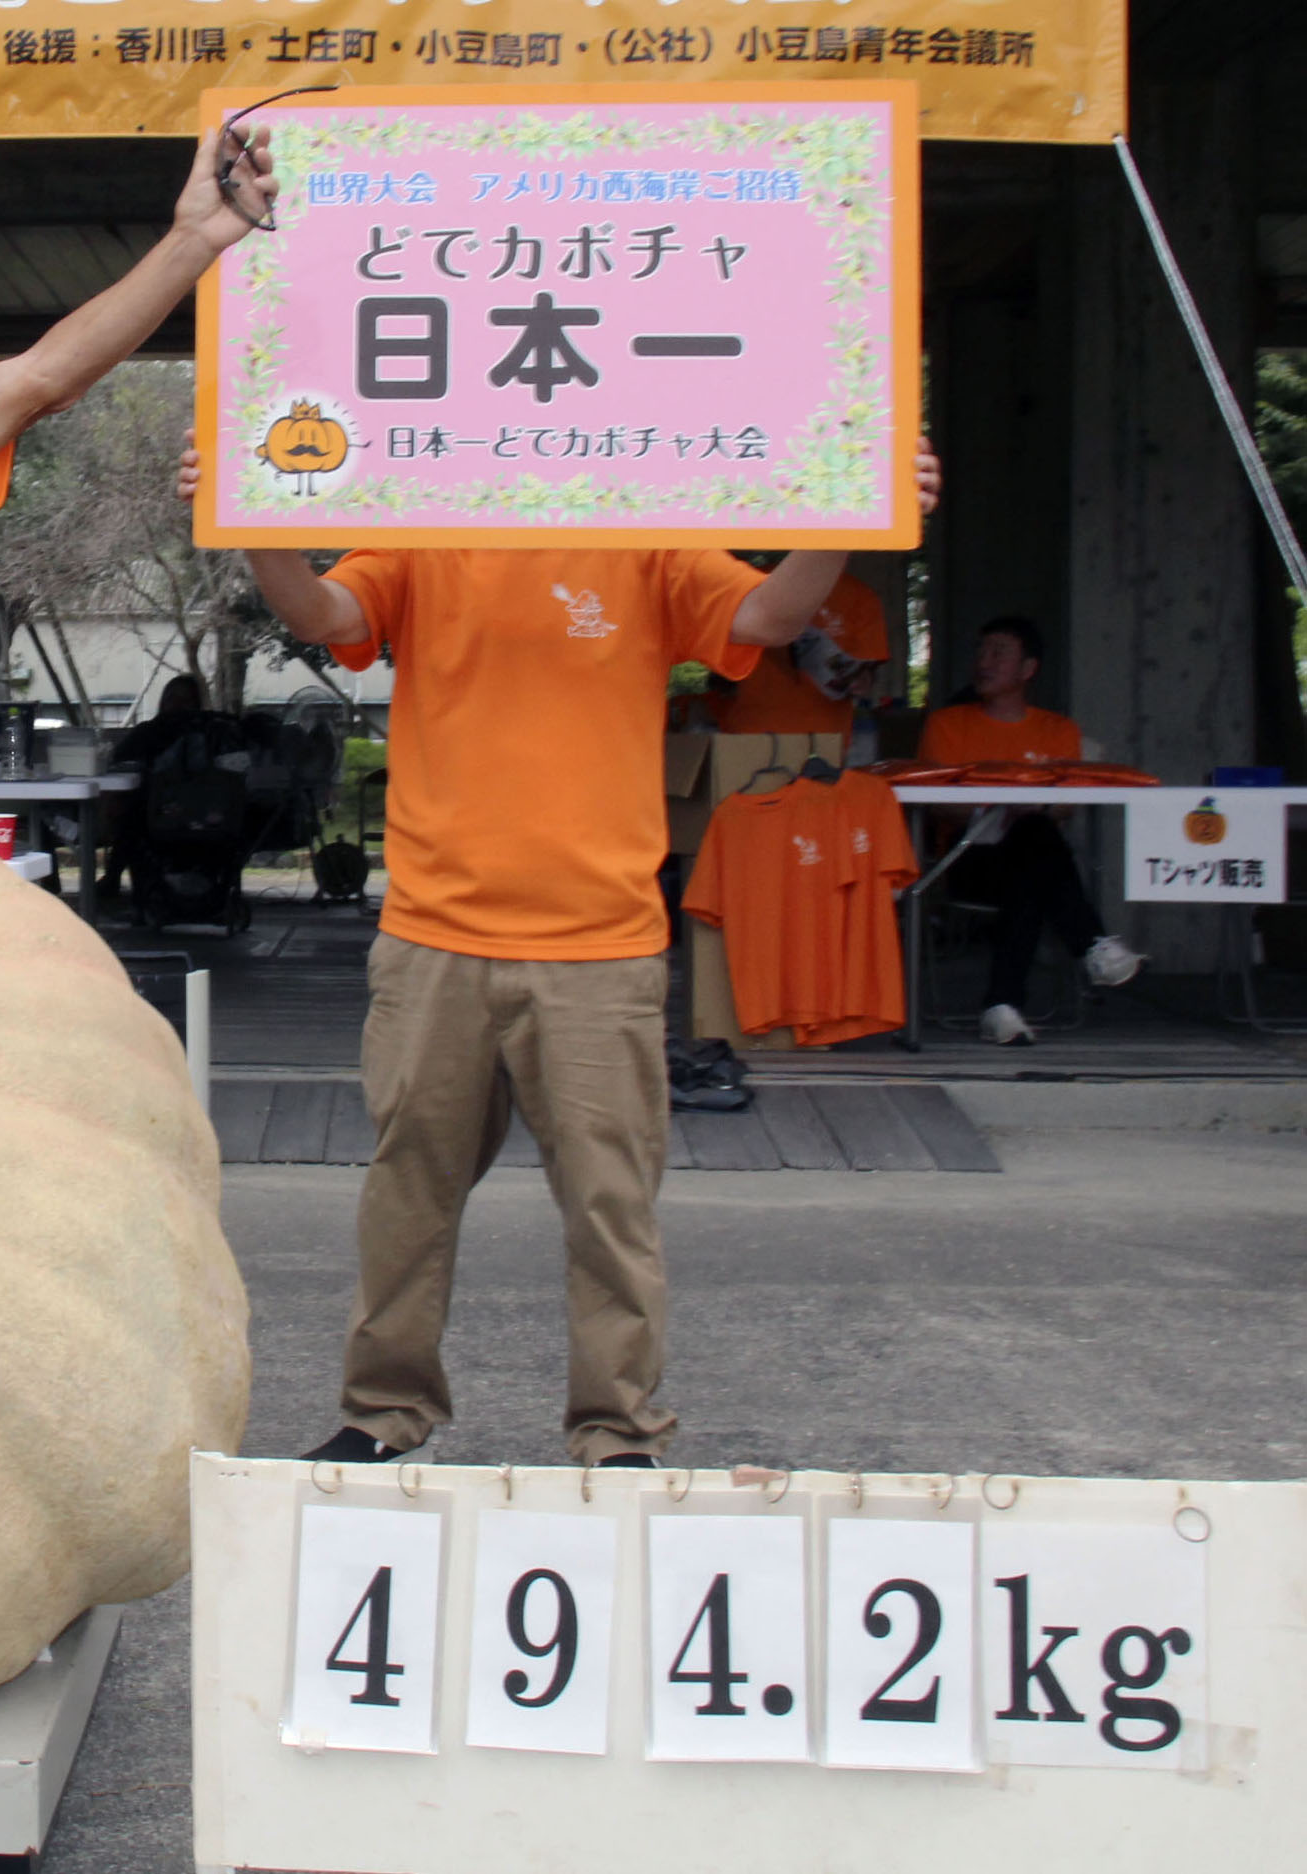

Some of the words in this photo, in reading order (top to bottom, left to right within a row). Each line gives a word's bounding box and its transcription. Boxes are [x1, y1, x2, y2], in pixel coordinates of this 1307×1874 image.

[307, 171, 438, 204] 世界大会
[472, 170, 802, 203] アメリカ西海岸ご招待
[357, 224, 748, 281] どでカボチャ
[358, 292, 742, 403] 日本一
[389, 426, 768, 460] 日本一どでカボチャ大会
[1146, 857, 1265, 888] Tシャツ販売
